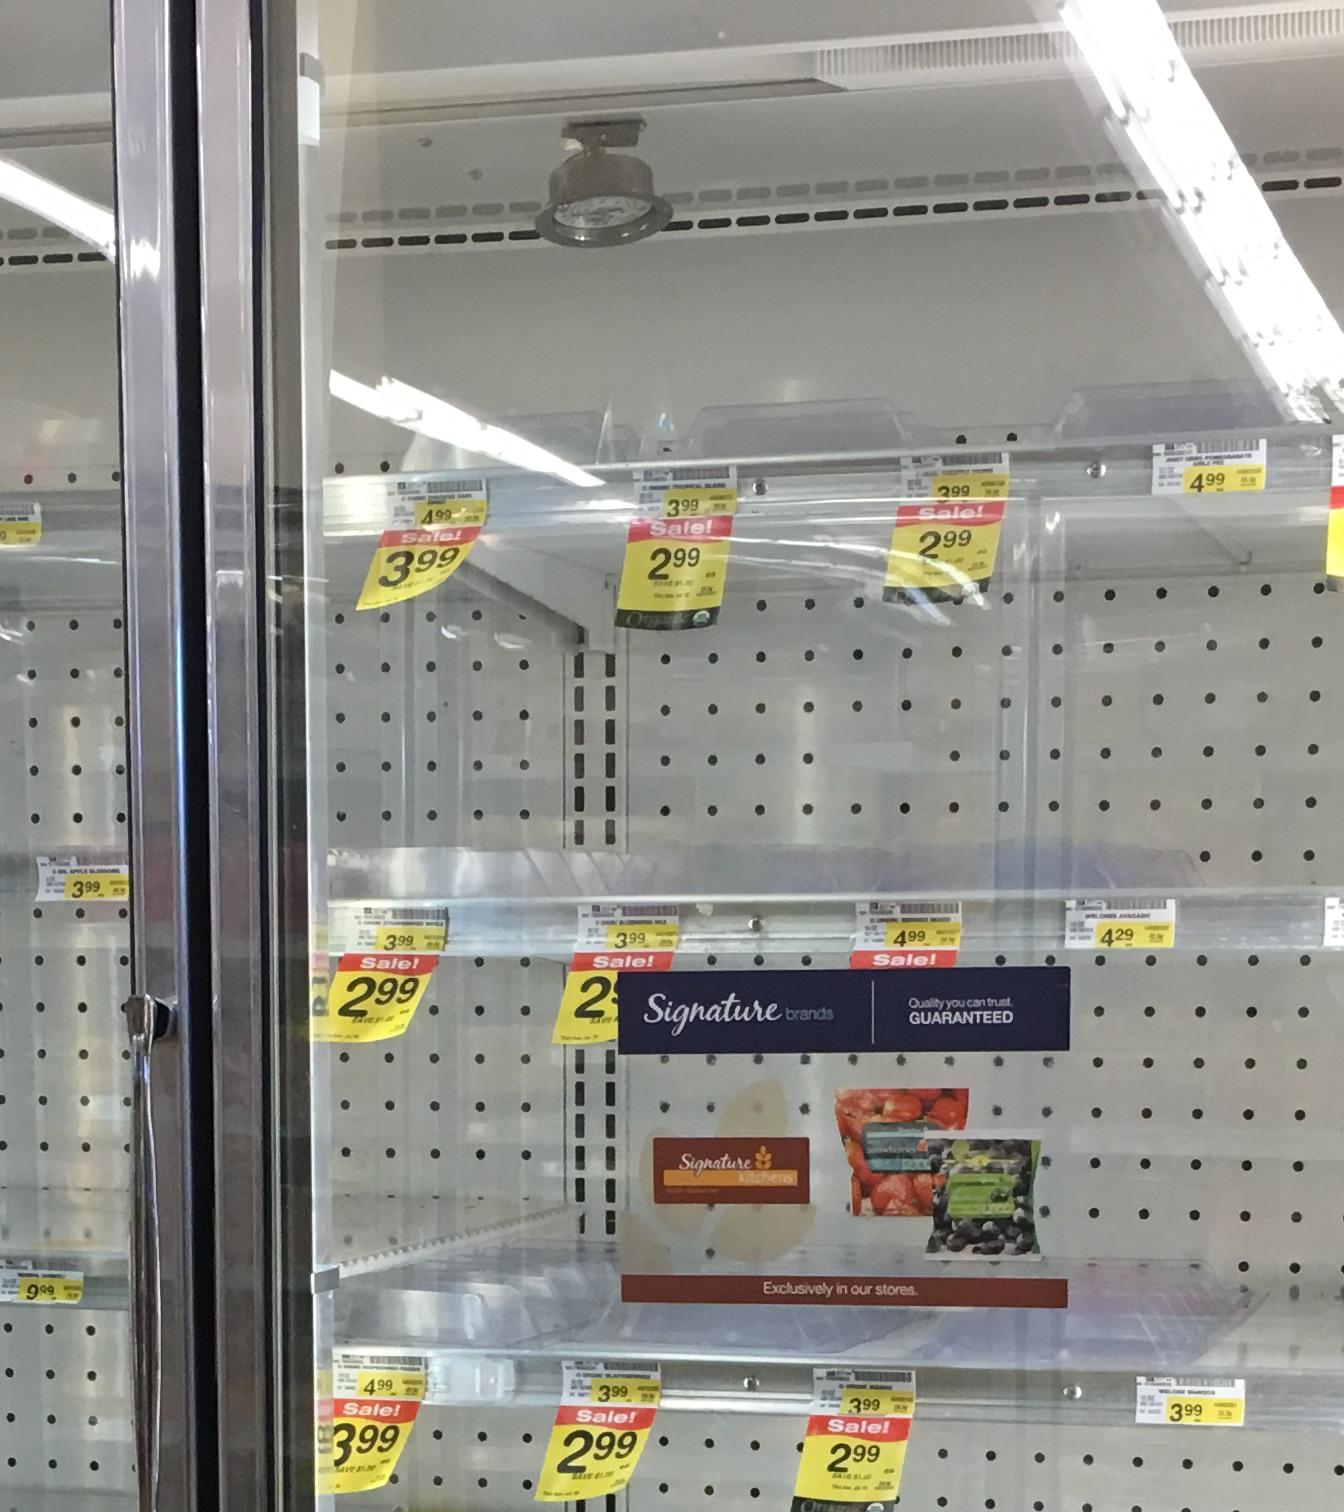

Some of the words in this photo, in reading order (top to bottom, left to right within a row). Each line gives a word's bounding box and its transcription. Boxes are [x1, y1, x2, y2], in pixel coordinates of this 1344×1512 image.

[1189, 472, 1225, 493] 499
[667, 498, 699, 517] 399
[918, 505, 983, 520] Sale!
[421, 509, 452, 525] 499
[649, 519, 712, 536] Sale!
[400, 530, 461, 545] Sale!
[918, 529, 972, 559] 299
[378, 547, 460, 588] 399
[647, 547, 701, 580] 299
[71, 880, 100, 898] 399
[383, 934, 413, 950] 399
[614, 931, 645, 949] 399
[892, 930, 926, 947] 499
[1100, 928, 1134, 947] 429
[359, 956, 419, 970] Sale!
[592, 955, 654, 970] Sale!
[872, 953, 936, 967] Sale!
[338, 976, 419, 1018] 299
[908, 997, 945, 1010] Quality
[945, 999, 966, 1010] you
[967, 999, 987, 1008] can
[643, 992, 782, 1037] Signature
[785, 1007, 834, 1021] brands
[909, 1010, 1014, 1025] GUARANTEED
[678, 1153, 752, 1177] Signature
[26, 1283, 54, 1301] 999
[763, 1280, 833, 1298] Exclusively
[836, 1282, 849, 1294] in
[851, 1285, 872, 1295] our
[874, 1284, 918, 1296] stores.
[363, 1379, 393, 1396] 499
[597, 1384, 628, 1403] 399
[342, 1402, 400, 1417] Sale!
[575, 1409, 635, 1424] Sale!
[1170, 1403, 1202, 1422] 399
[827, 1417, 889, 1434] Sale!
[333, 1422, 400, 1467] 399
[557, 1429, 638, 1474] 299
[827, 1443, 880, 1473] 299
